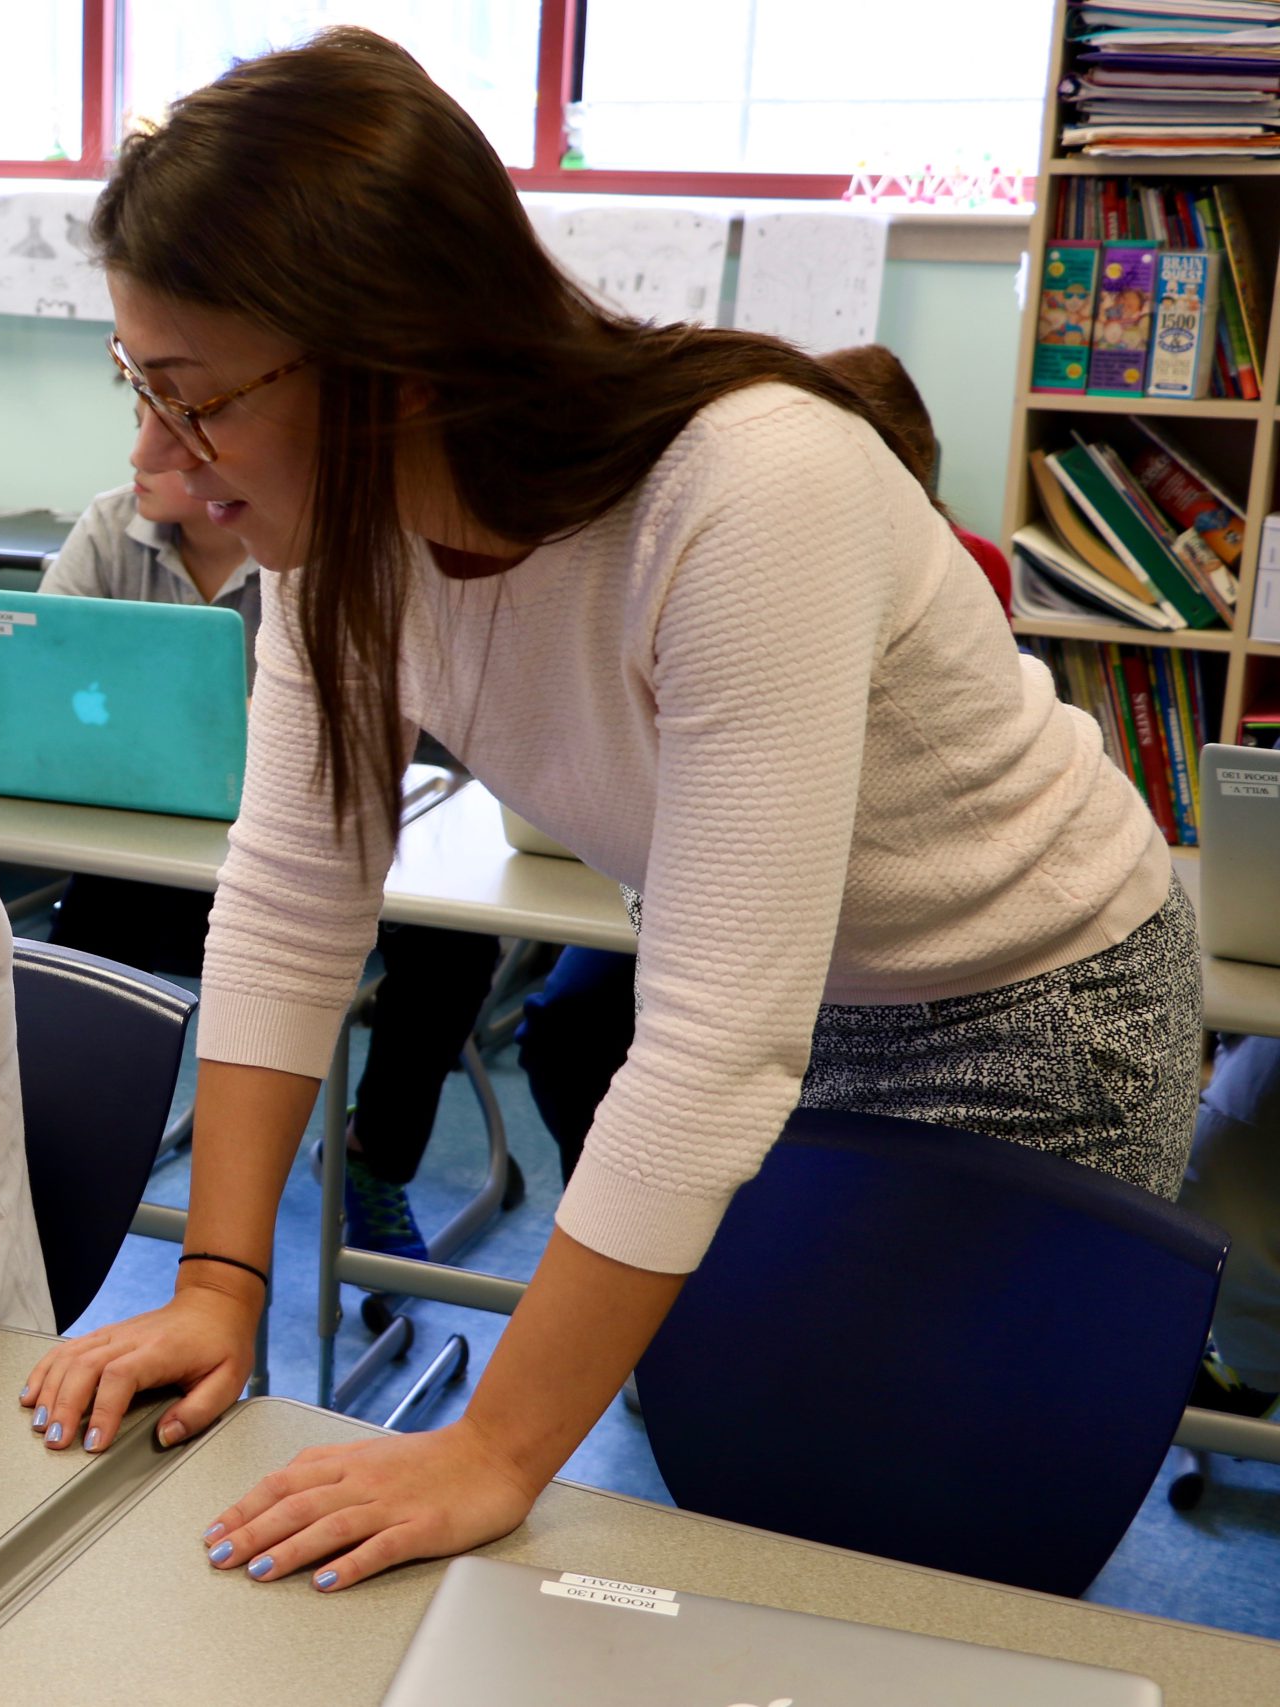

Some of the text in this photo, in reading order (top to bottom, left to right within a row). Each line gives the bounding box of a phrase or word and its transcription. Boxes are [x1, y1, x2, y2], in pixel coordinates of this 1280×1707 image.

[1161, 256, 1204, 271] BRAIN
[1160, 270, 1204, 286] QUEST
[1161, 313, 1196, 330] 1500
[1244, 773, 1278, 782] ROOM
[1241, 786, 1269, 795] WILL
[576, 1577, 657, 1595] KENDALL
[566, 1587, 656, 1609] ROOM 130
